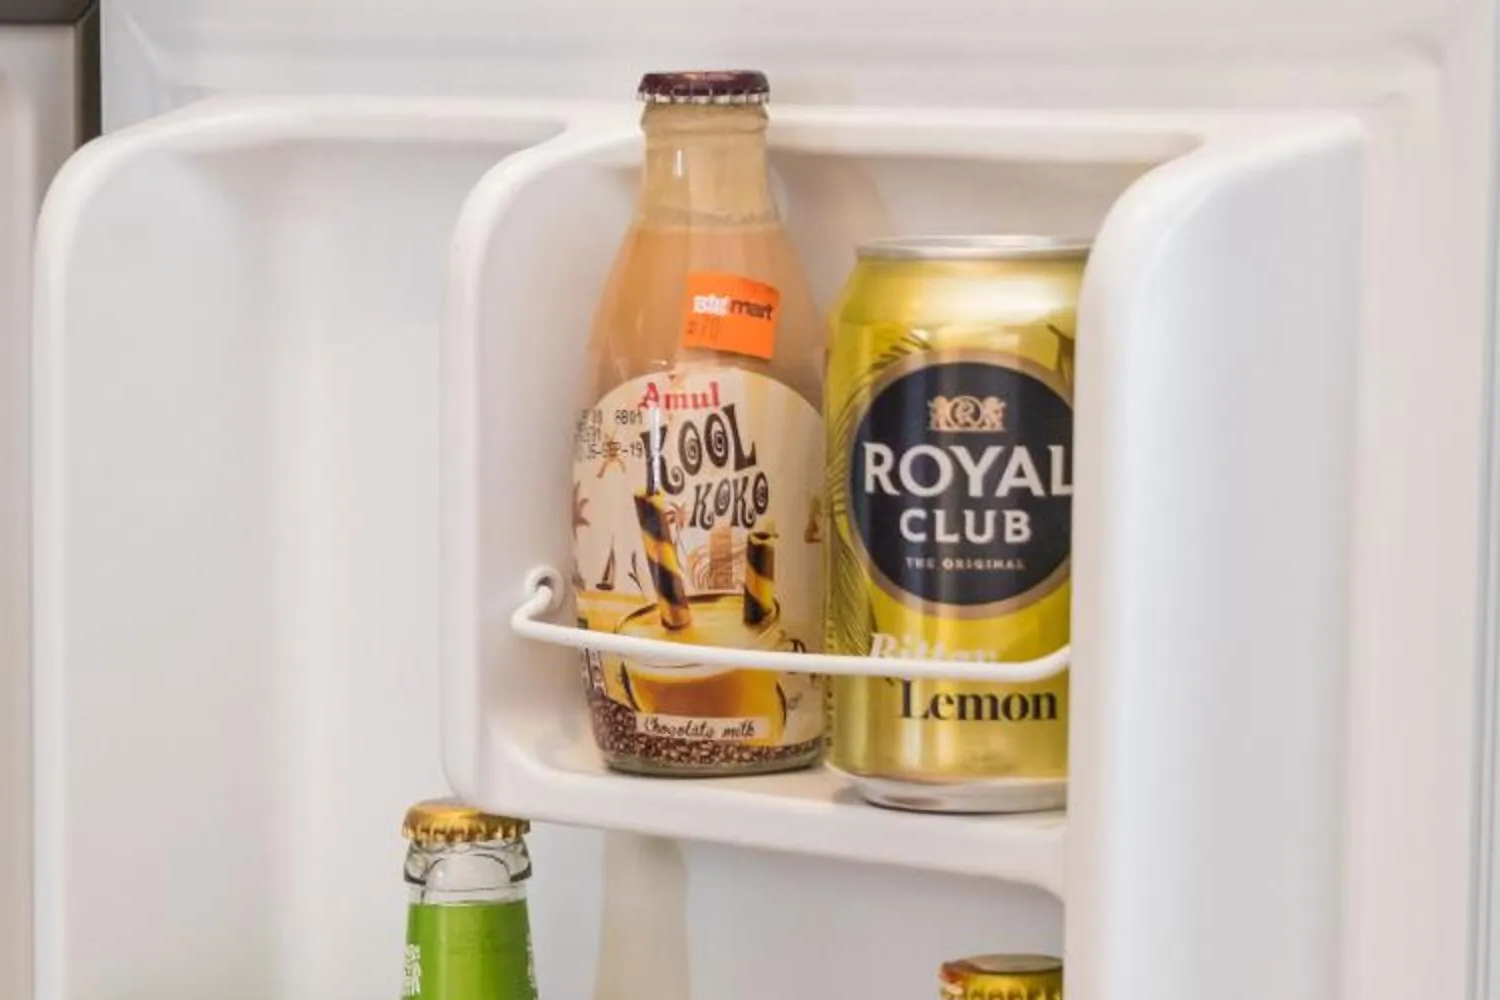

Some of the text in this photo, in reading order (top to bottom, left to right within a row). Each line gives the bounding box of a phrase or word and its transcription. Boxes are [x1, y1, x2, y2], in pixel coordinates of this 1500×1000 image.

[640, 381, 721, 410] Amul
[639, 403, 757, 496] KOOL
[862, 442, 1074, 498] ROYAL
[689, 471, 770, 531] KOKO
[899, 508, 1033, 544] CLUB
[905, 556, 1026, 572] THE ORIGINAL
[899, 678, 1058, 721] Lemon
[722, 719, 755, 738] milk
